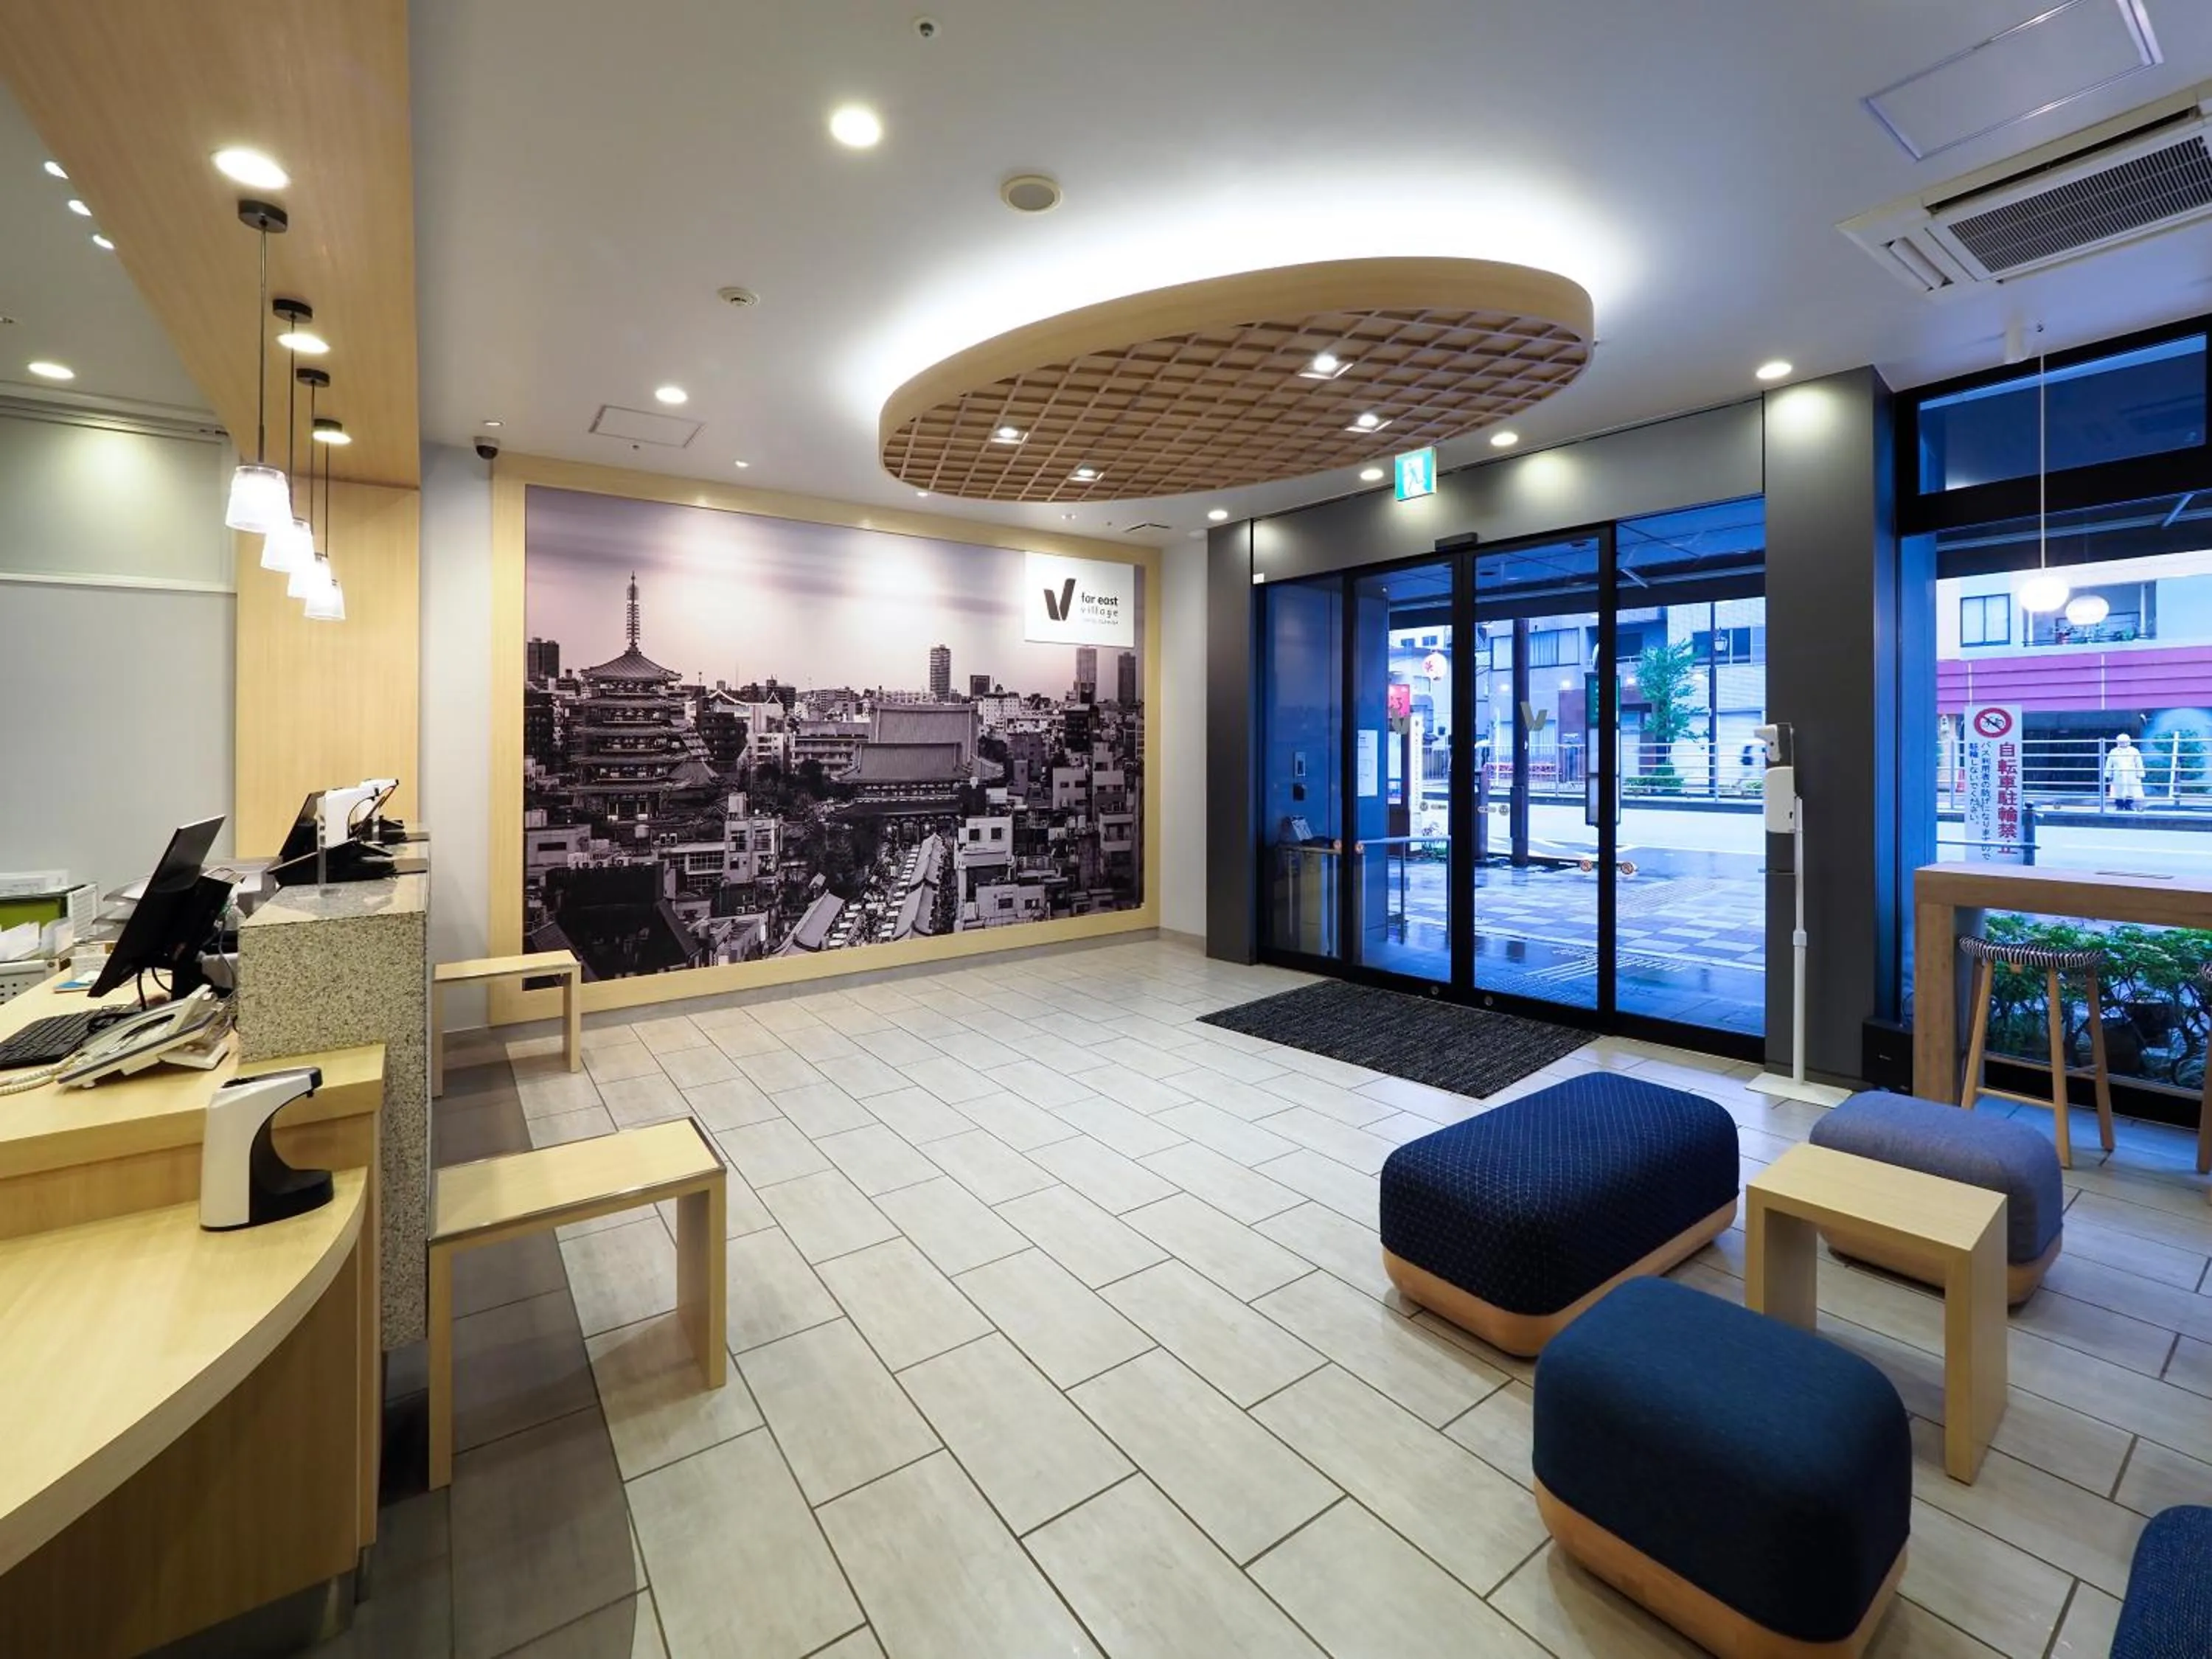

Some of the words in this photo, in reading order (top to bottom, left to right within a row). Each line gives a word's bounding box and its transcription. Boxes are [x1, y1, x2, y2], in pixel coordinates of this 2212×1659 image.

[1082, 592, 1096, 603] far
[1098, 597, 1118, 606] east
[1080, 605, 1119, 619] village
[1997, 741, 2018, 854] 自転車駐輪禁止
